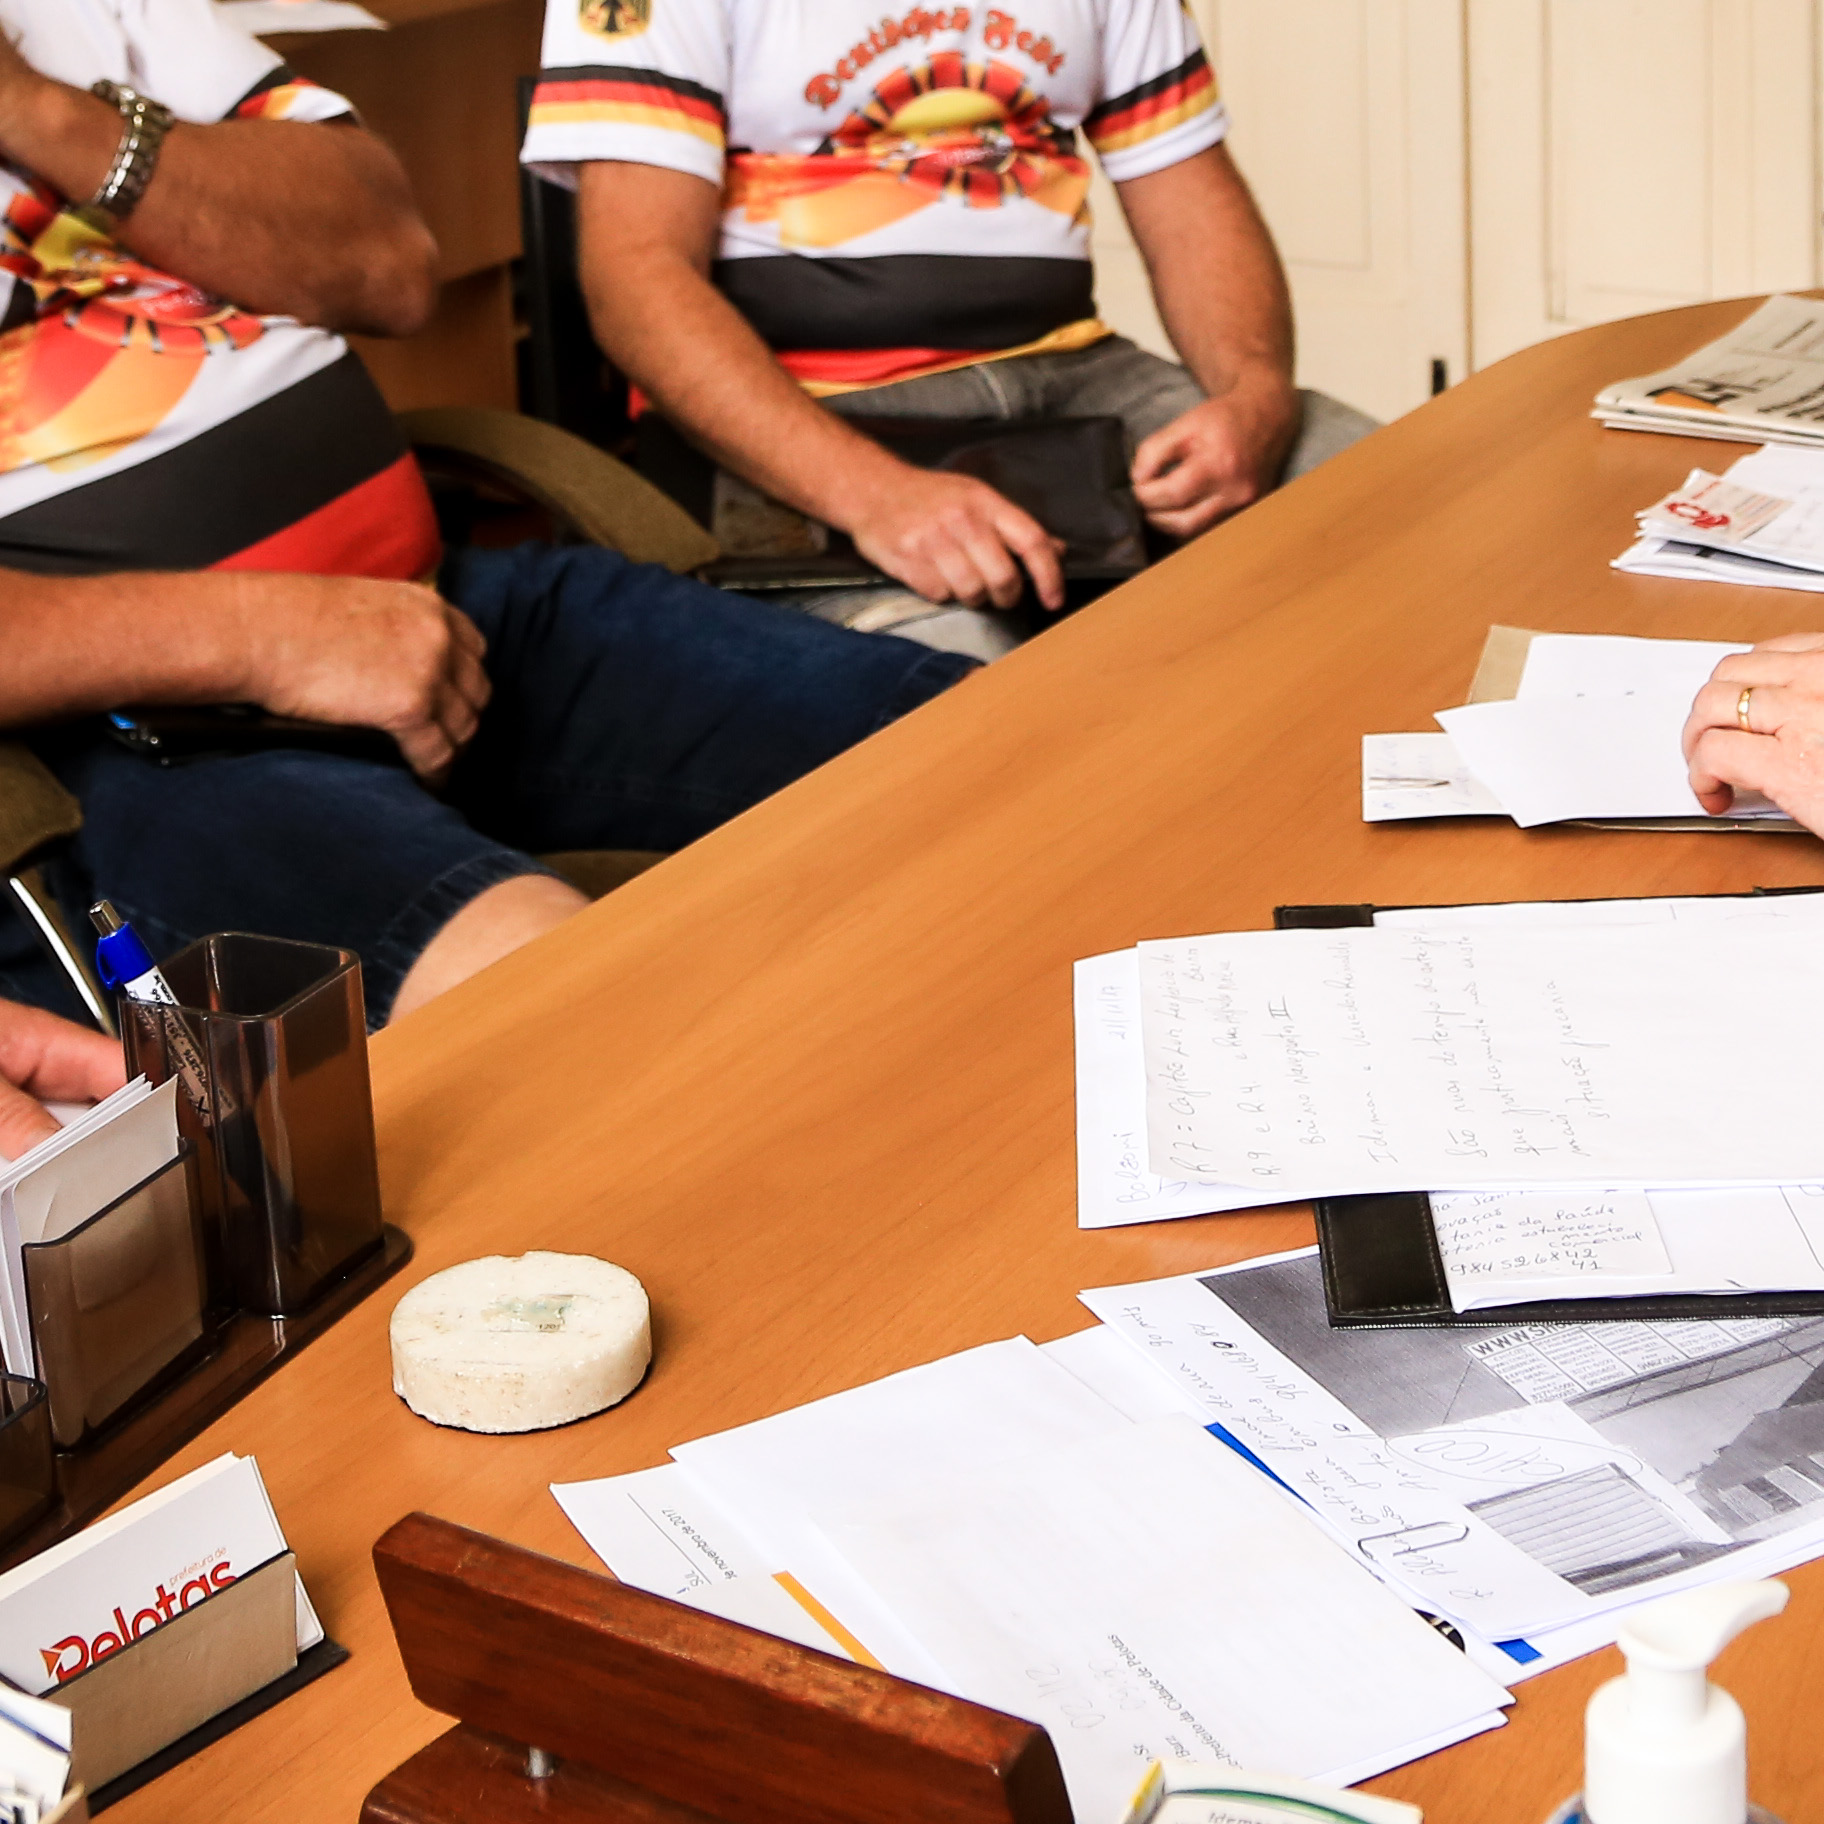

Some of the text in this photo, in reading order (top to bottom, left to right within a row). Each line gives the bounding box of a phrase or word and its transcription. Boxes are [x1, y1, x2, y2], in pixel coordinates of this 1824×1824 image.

[1512, 1128, 1559, 1158] que
[661, 1509, 686, 1527] 2017
[681, 1525, 696, 1535] de
[691, 1534, 728, 1570] novembro
[44, 1559, 239, 1683] Pelotas
[1107, 1634, 1142, 1668] Pelotas
[1137, 1666, 1153, 1678] de
[1149, 1679, 1183, 1711] Cidade
[1179, 1710, 1196, 1723] da
